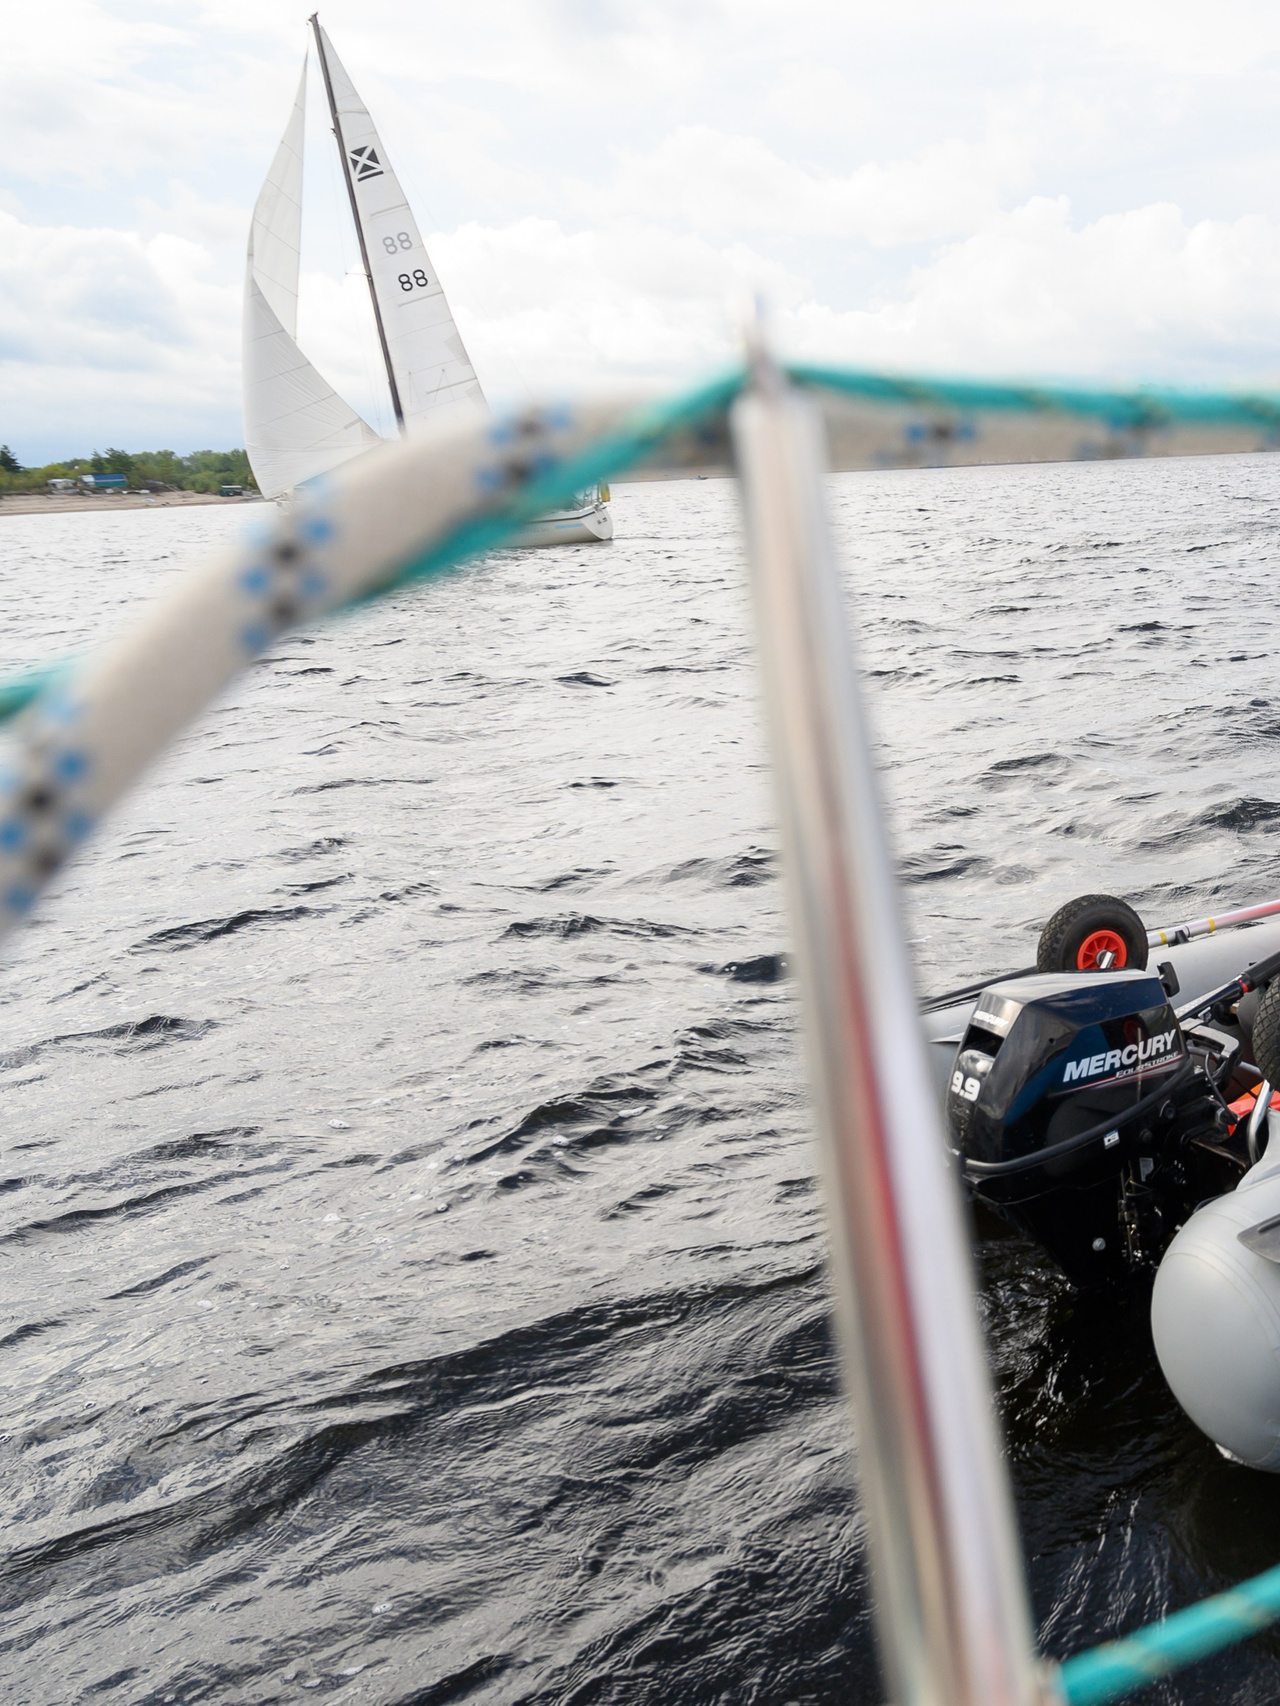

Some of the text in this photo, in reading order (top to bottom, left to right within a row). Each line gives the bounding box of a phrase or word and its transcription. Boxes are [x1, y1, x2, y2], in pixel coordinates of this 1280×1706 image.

[382, 231, 413, 255] 88
[398, 269, 428, 291] 88
[1063, 1029, 1177, 1082] MERCURY
[951, 1070, 980, 1102] 9.9
